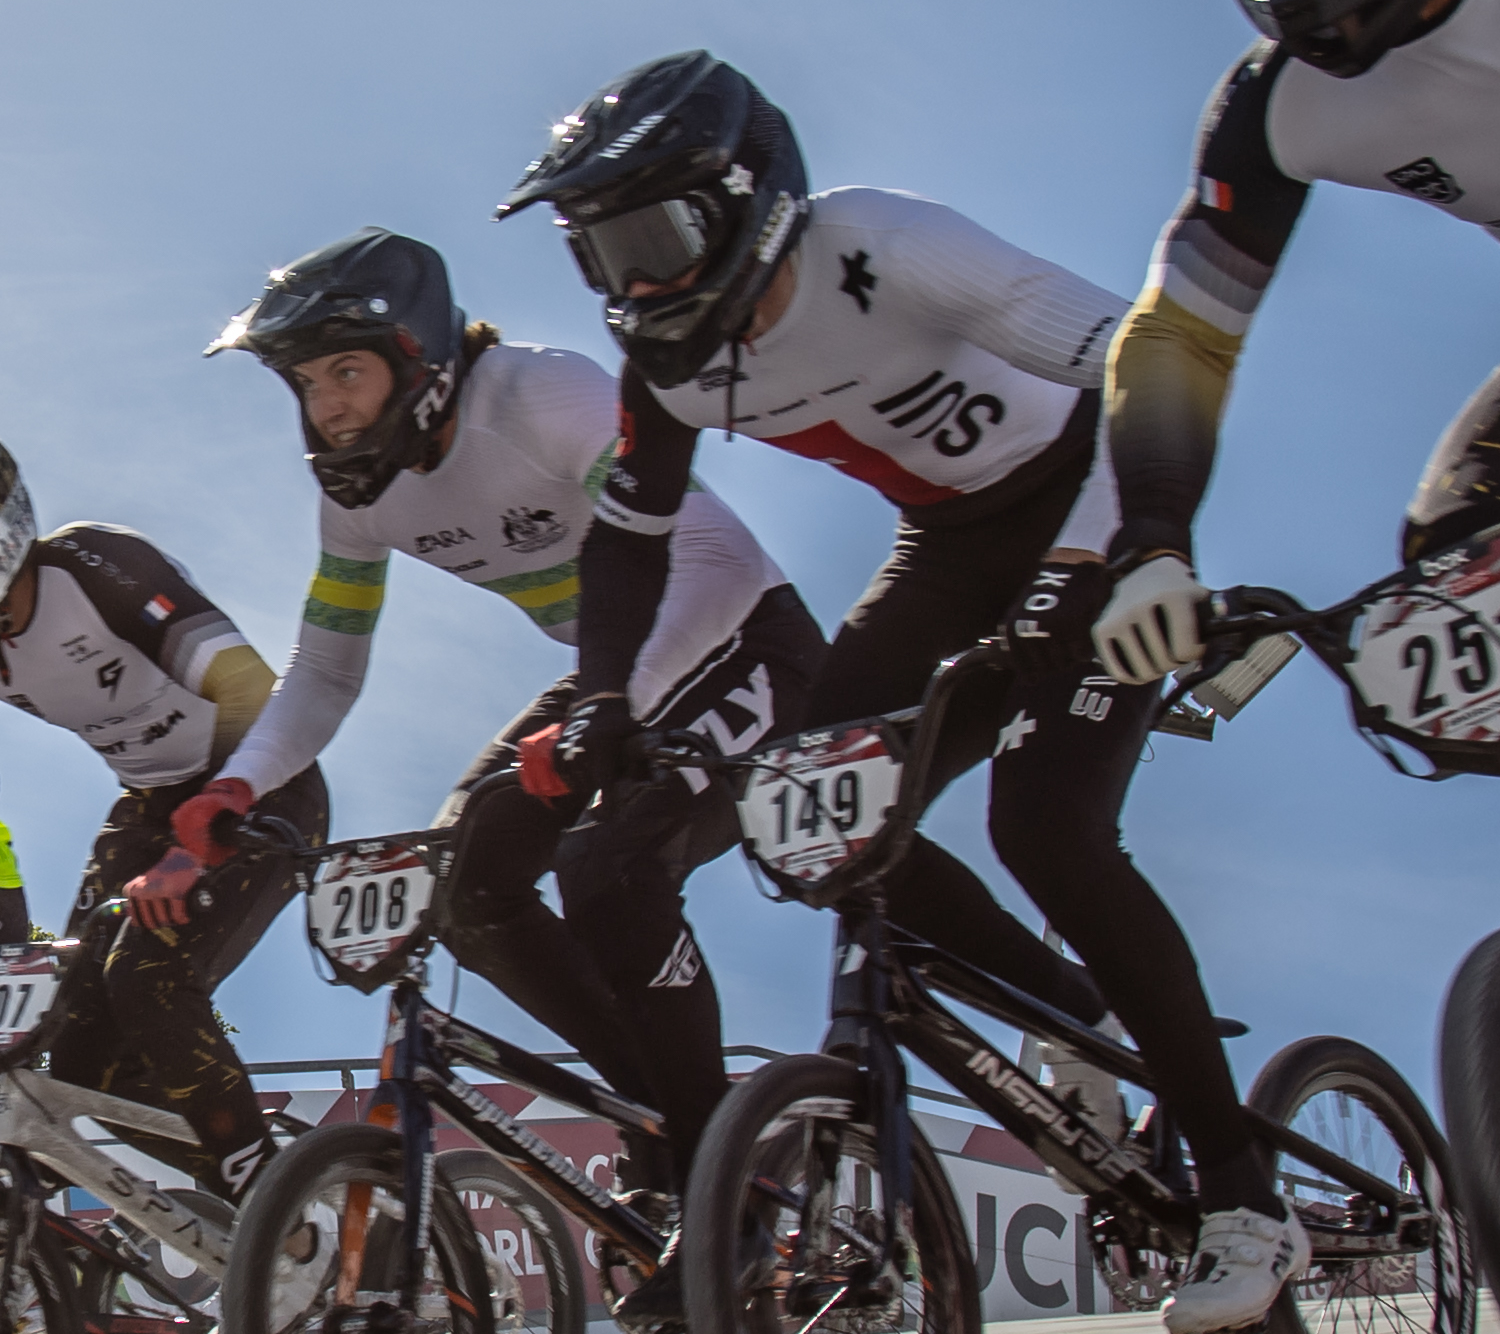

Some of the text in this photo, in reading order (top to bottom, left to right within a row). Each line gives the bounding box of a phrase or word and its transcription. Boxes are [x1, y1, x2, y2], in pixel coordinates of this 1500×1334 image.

[1014, 570, 1073, 638] FOX
[770, 770, 860, 846] 149
[332, 876, 408, 940] 208
